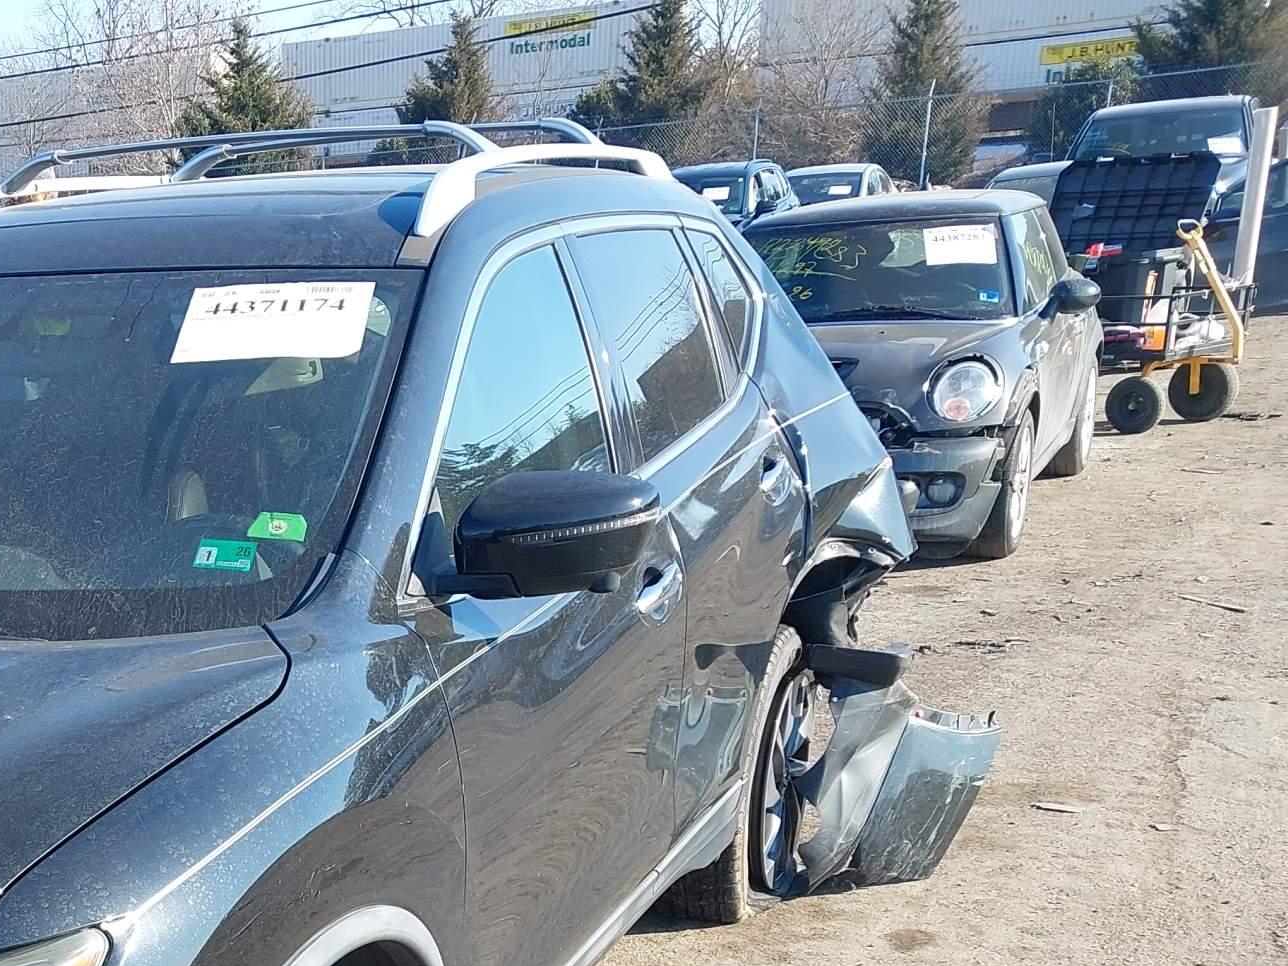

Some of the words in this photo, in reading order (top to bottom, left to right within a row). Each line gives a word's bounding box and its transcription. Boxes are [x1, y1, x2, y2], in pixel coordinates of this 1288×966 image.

[510, 33, 591, 54] Intermodal
[205, 298, 346, 315] 44371174
[235, 546, 252, 557] 26
